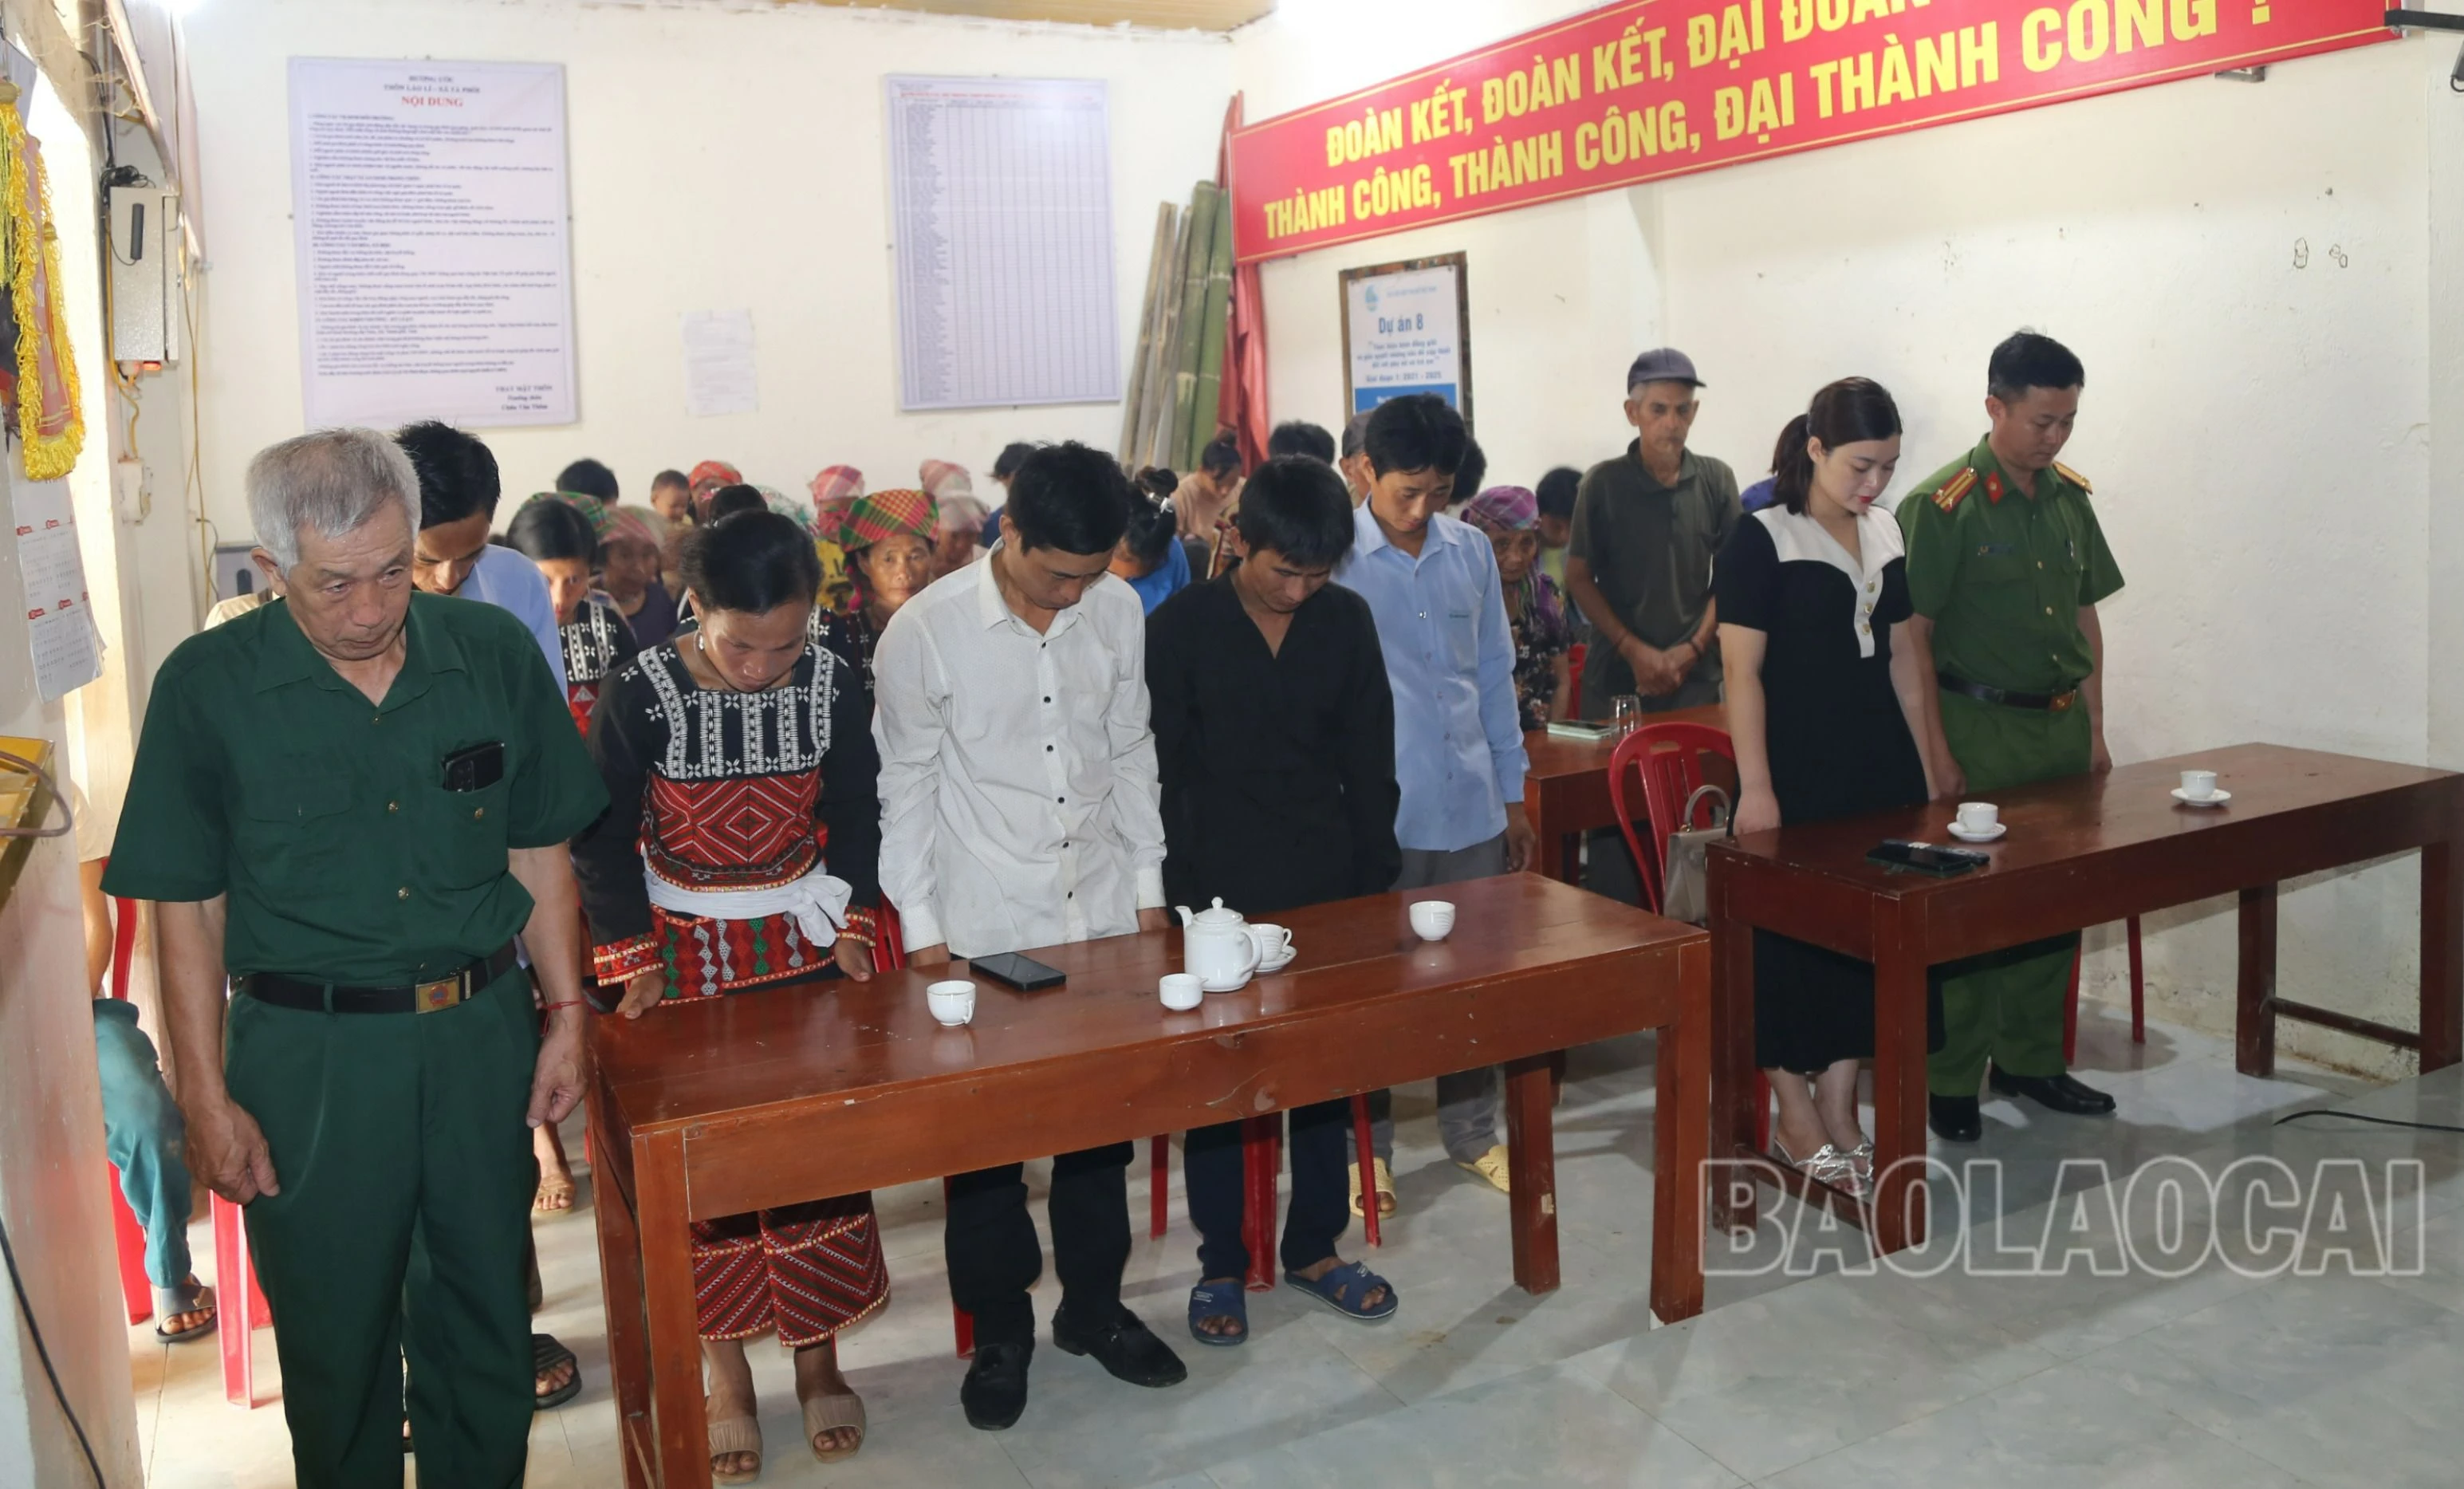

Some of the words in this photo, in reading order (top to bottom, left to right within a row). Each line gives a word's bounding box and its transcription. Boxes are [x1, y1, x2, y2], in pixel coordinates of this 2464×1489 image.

[401, 96, 424, 108] NỘI
[427, 97, 463, 108] DUNG
[1264, 185, 1346, 238] THÀNH
[1352, 163, 1442, 220] CÔNG,
[1449, 130, 1563, 198] THÀNH
[1575, 100, 1700, 170] CÔNG,
[1714, 72, 1795, 144] ĐẠI
[1809, 21, 2000, 118] THÀNH
[1326, 108, 1403, 167] ĐOÀN
[1411, 79, 1473, 144] KẾT,
[1482, 53, 1580, 124] ĐOÀN
[1593, 17, 1674, 93] KẾT,
[1687, 0, 1765, 69] ĐẠI
[1780, 0, 1931, 43] ĐO
[1379, 317, 1394, 337] Dự
[1397, 314, 1412, 333] án
[1415, 313, 1424, 330] 8
